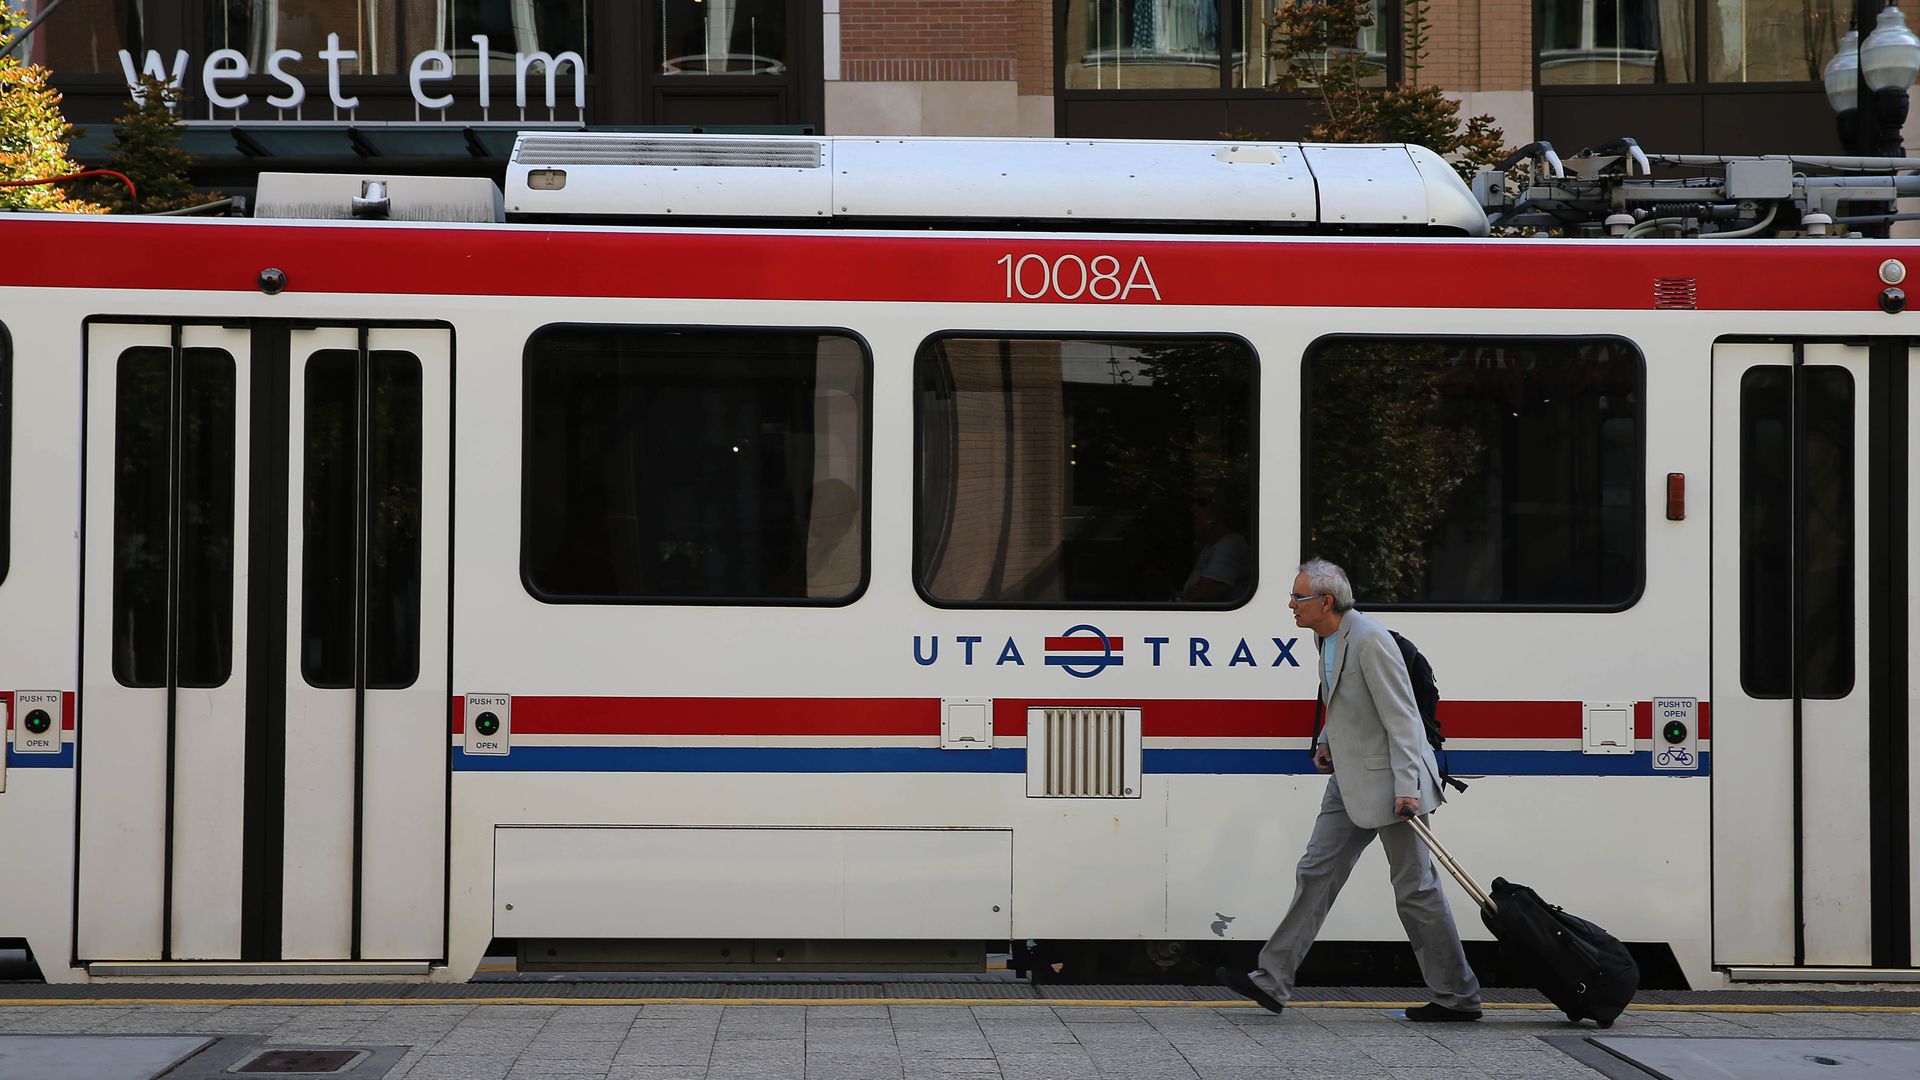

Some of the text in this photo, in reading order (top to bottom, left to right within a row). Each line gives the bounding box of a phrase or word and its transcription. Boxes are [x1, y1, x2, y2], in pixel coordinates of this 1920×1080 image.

[118, 32, 586, 109] west elm
[997, 253, 1162, 301] 1008A
[913, 635, 1301, 667] UTA TRAX
[19, 695, 59, 703] PUSH TO
[469, 698, 507, 706] PUSH TO
[1658, 701, 1693, 709] PUSH TO
[1663, 710, 1687, 719] OPEN
[26, 739, 50, 748] OPEN
[475, 741, 499, 750] OPEN
